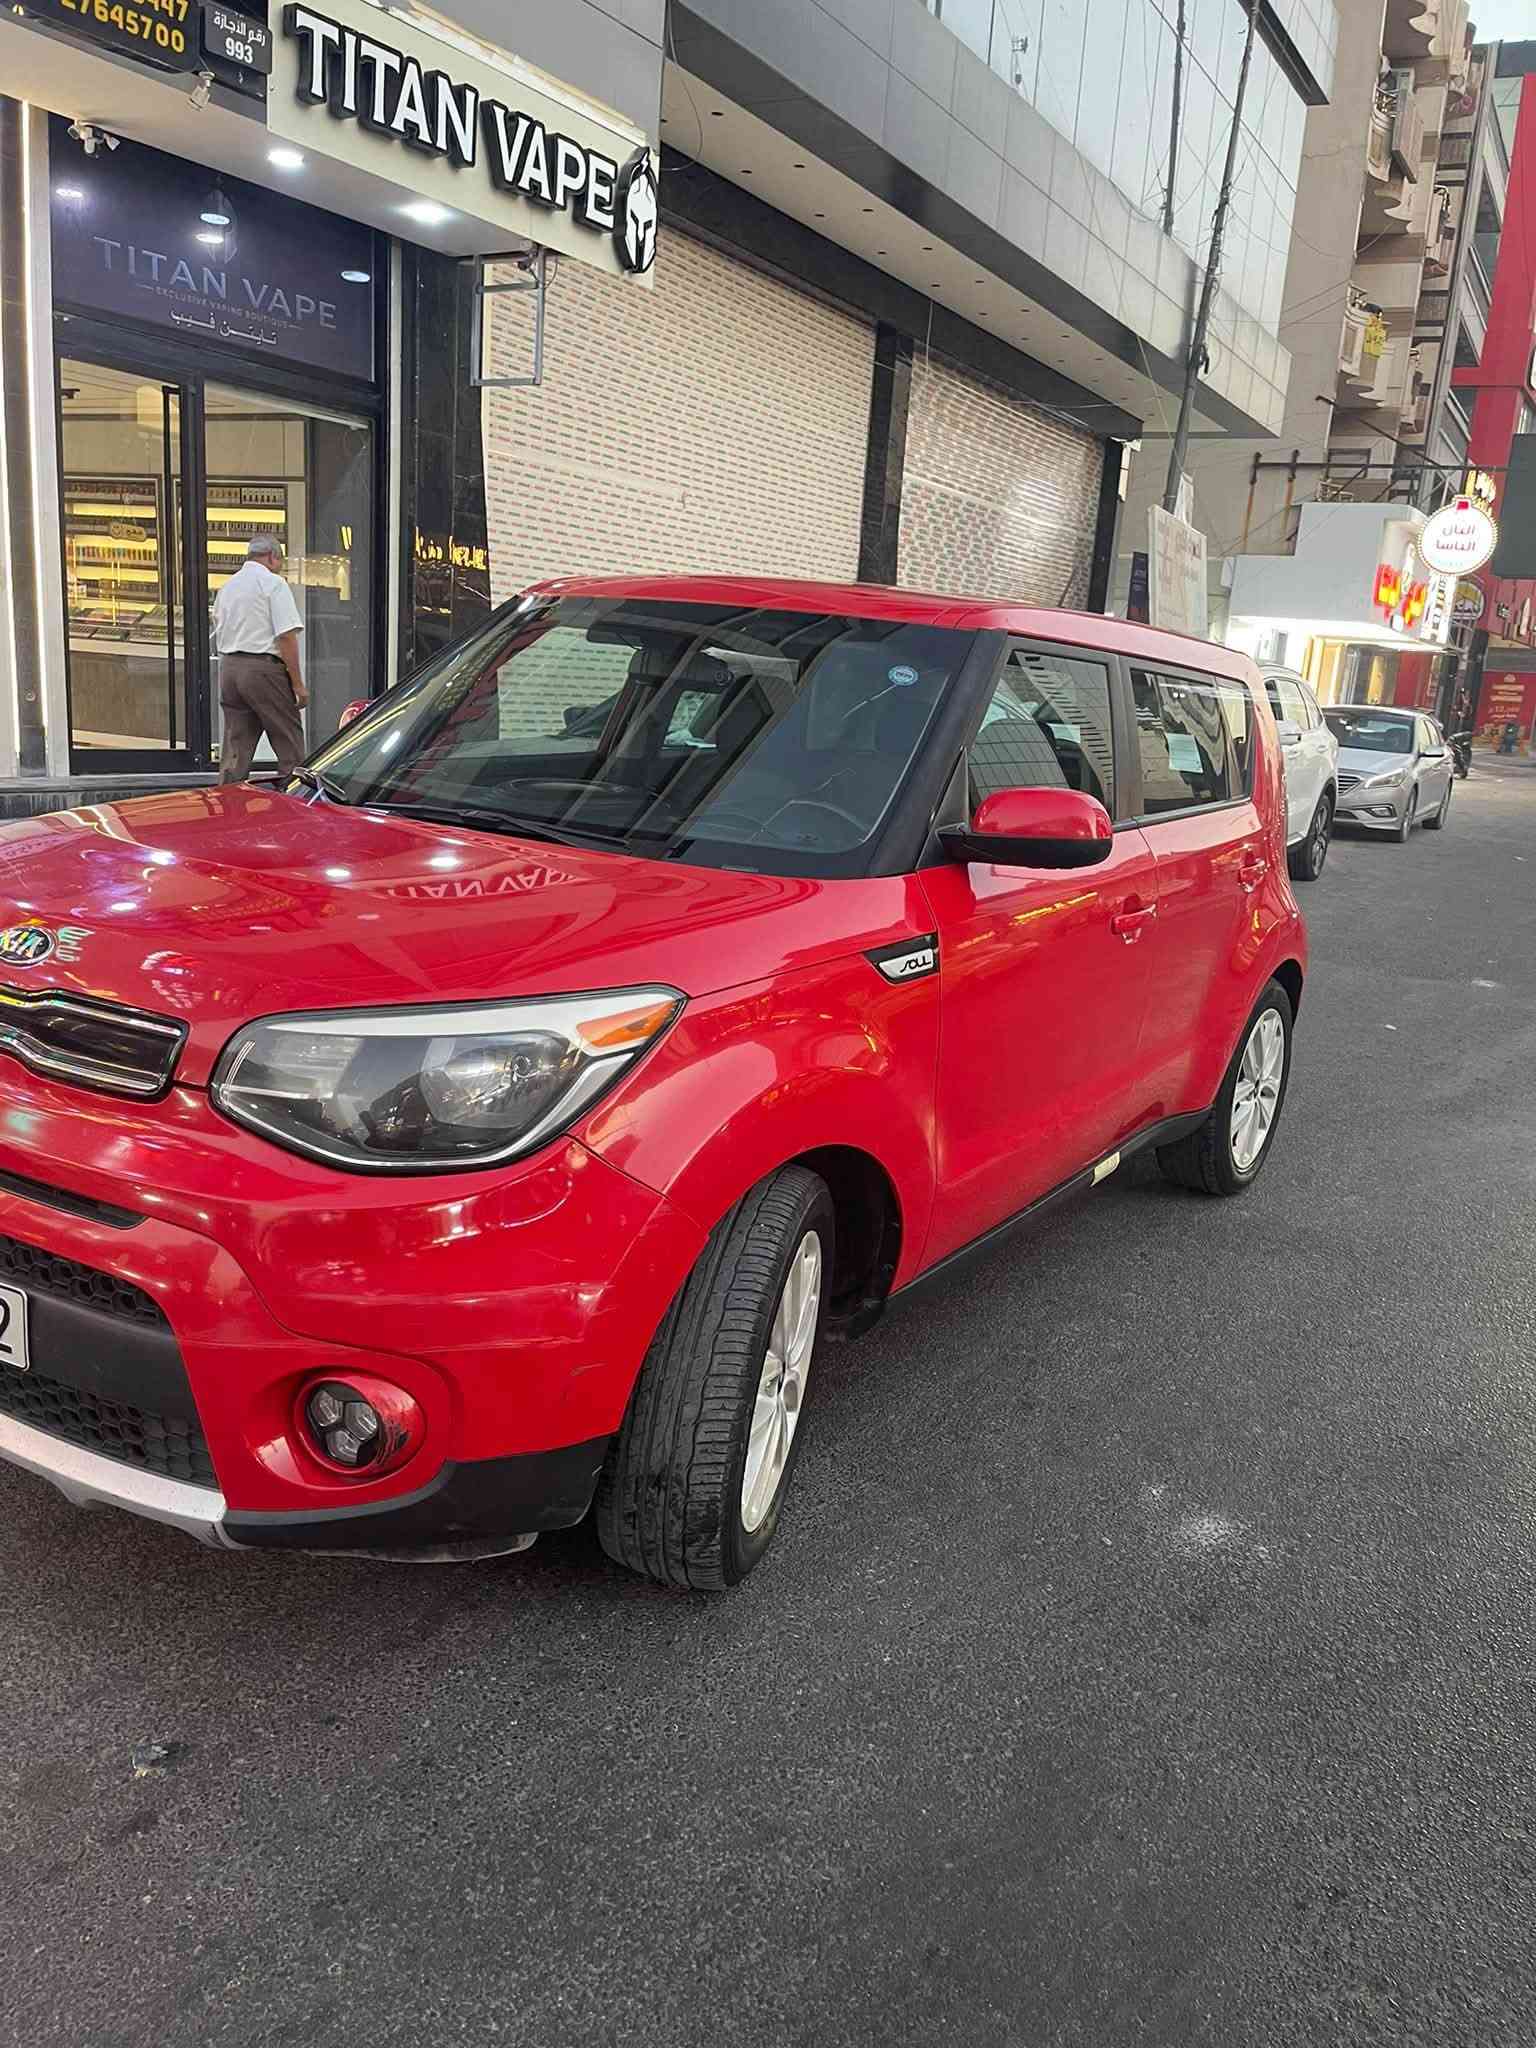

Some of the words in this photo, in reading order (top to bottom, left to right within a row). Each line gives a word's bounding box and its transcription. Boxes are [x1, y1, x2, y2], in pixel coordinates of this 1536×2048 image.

[225, 37, 253, 64] 993
[247, 29, 266, 47] رقم
[292, 5, 479, 165] TITAN
[490, 101, 619, 230] VAPE
[93, 236, 227, 299] TITAN
[241, 278, 337, 329] VAPE
